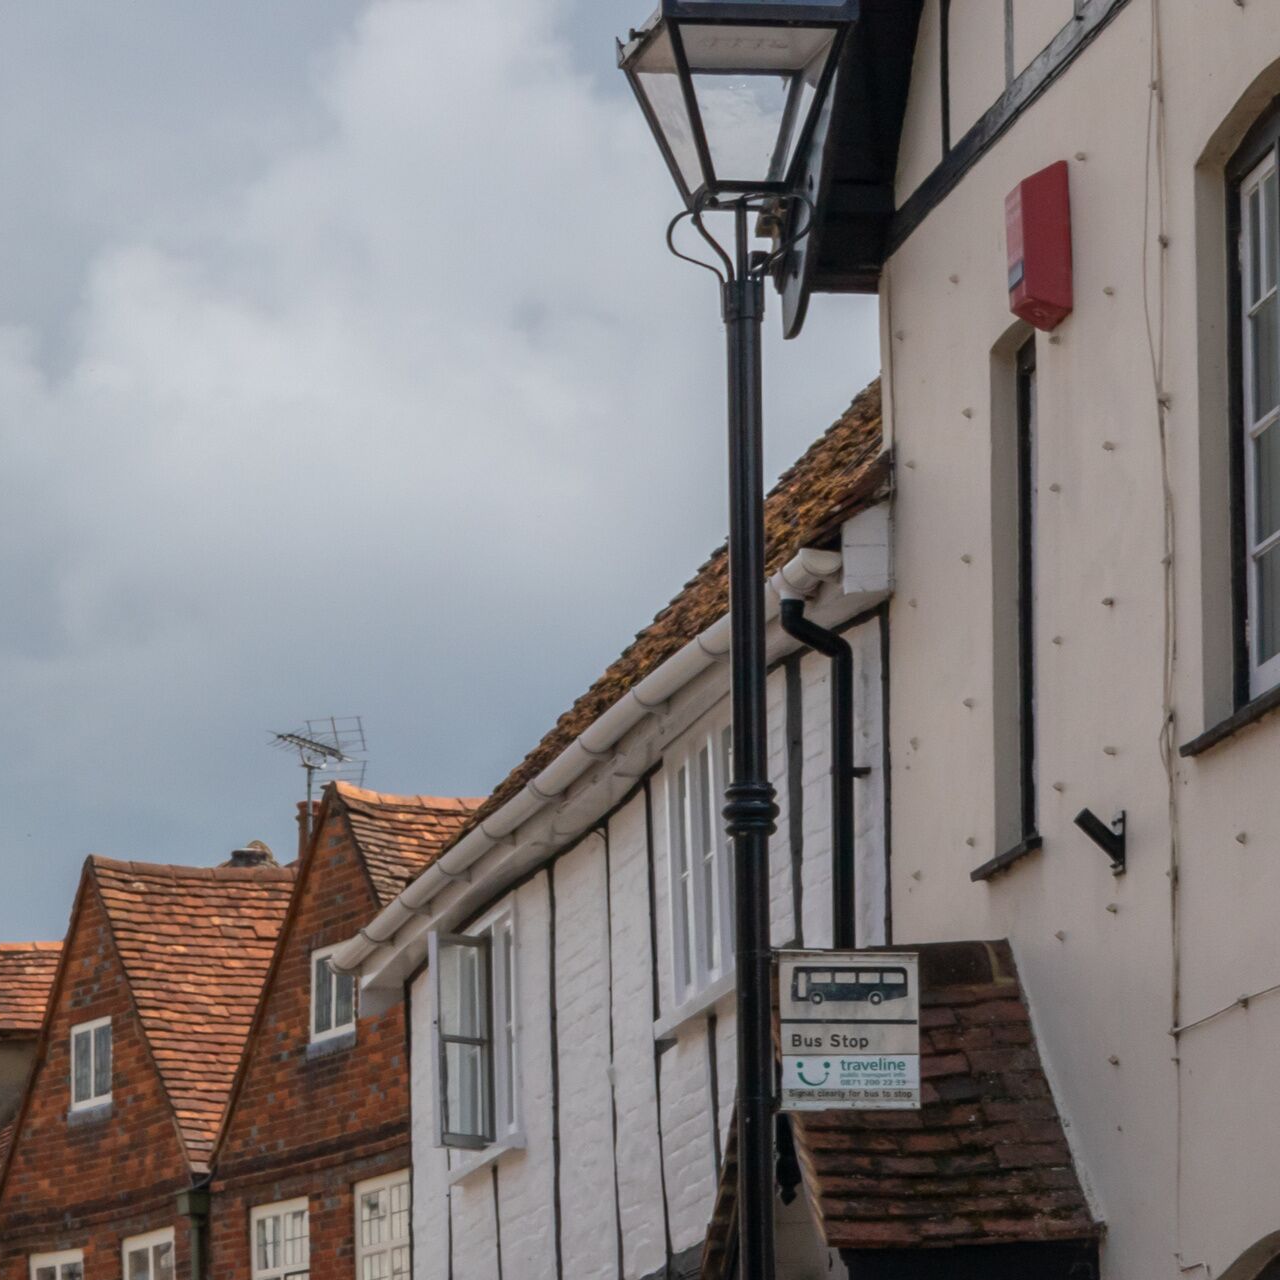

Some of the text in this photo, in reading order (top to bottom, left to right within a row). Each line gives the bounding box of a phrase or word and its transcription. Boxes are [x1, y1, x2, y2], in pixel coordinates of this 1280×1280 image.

[791, 1033, 870, 1050] Bus Stop
[840, 1058, 906, 1072] traveline
[789, 1088, 913, 1099] Signal clearly for bus to stop
